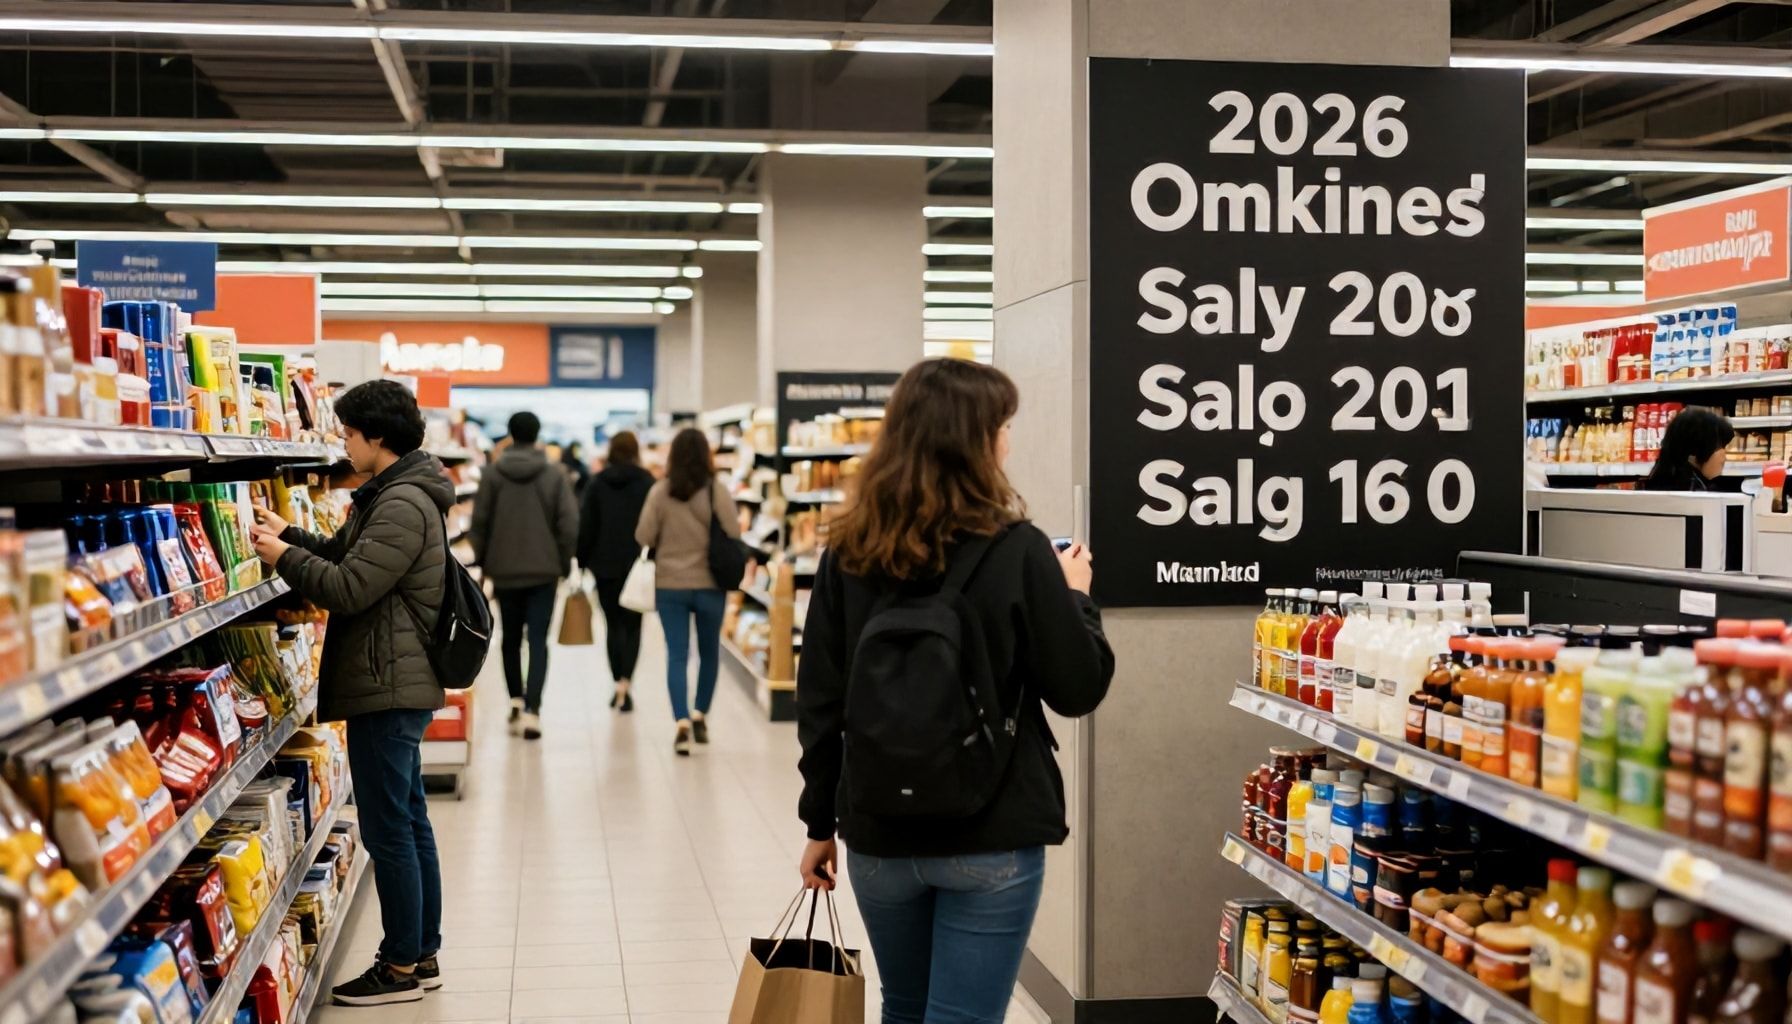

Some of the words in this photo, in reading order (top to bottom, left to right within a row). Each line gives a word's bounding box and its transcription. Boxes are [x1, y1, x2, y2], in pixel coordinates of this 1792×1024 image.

[1208, 91, 1409, 158] 2026
[1137, 267, 1306, 352] Saly
[1137, 459, 1304, 541] Salg
